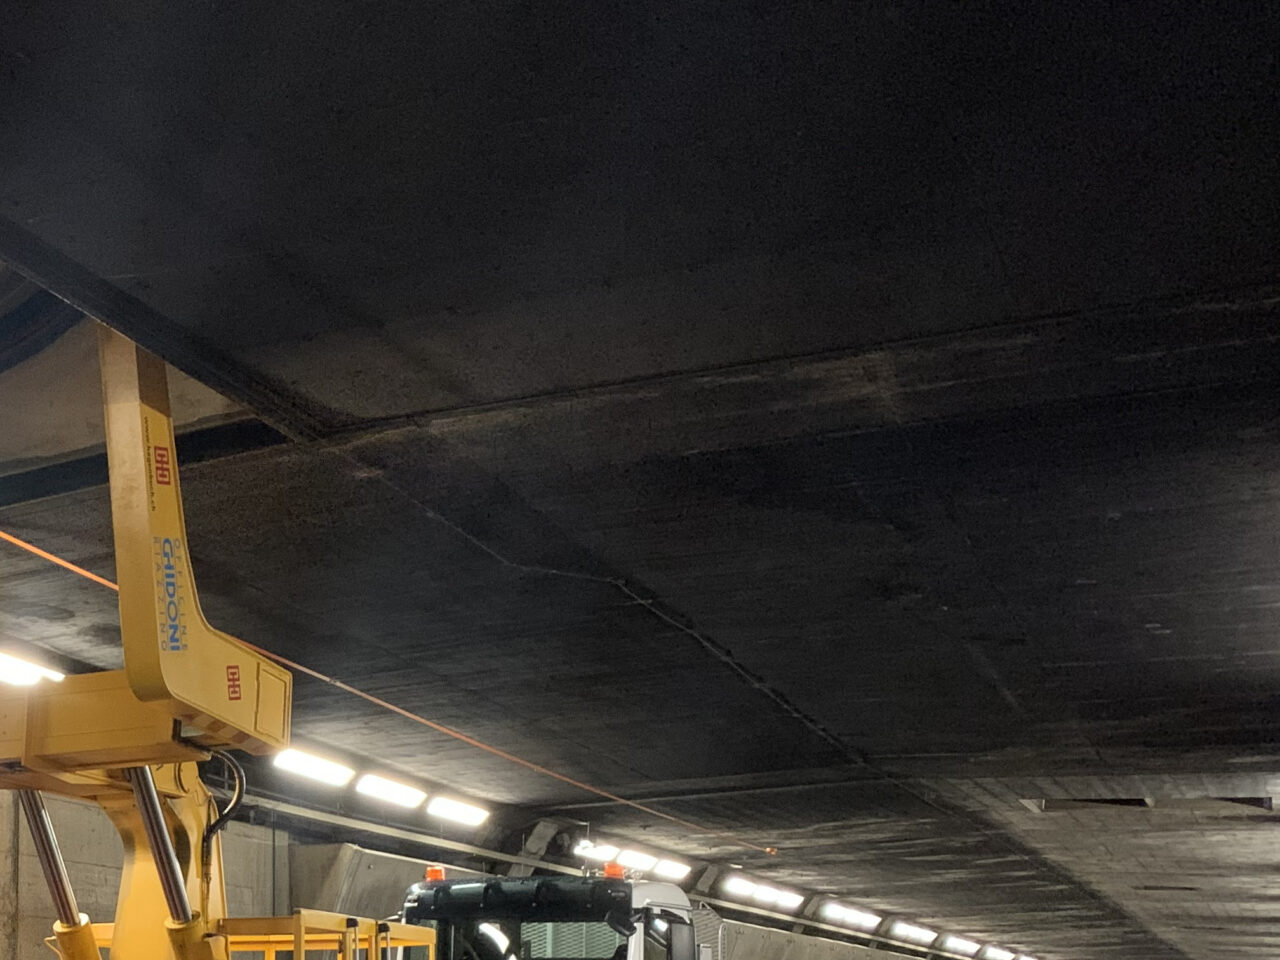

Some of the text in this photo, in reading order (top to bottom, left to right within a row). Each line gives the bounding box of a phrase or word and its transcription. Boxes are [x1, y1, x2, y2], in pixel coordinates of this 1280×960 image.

[153, 536, 168, 652] RIAZZINO
[163, 538, 181, 651] GHIDONI
[175, 538, 189, 651] OFFICINE
